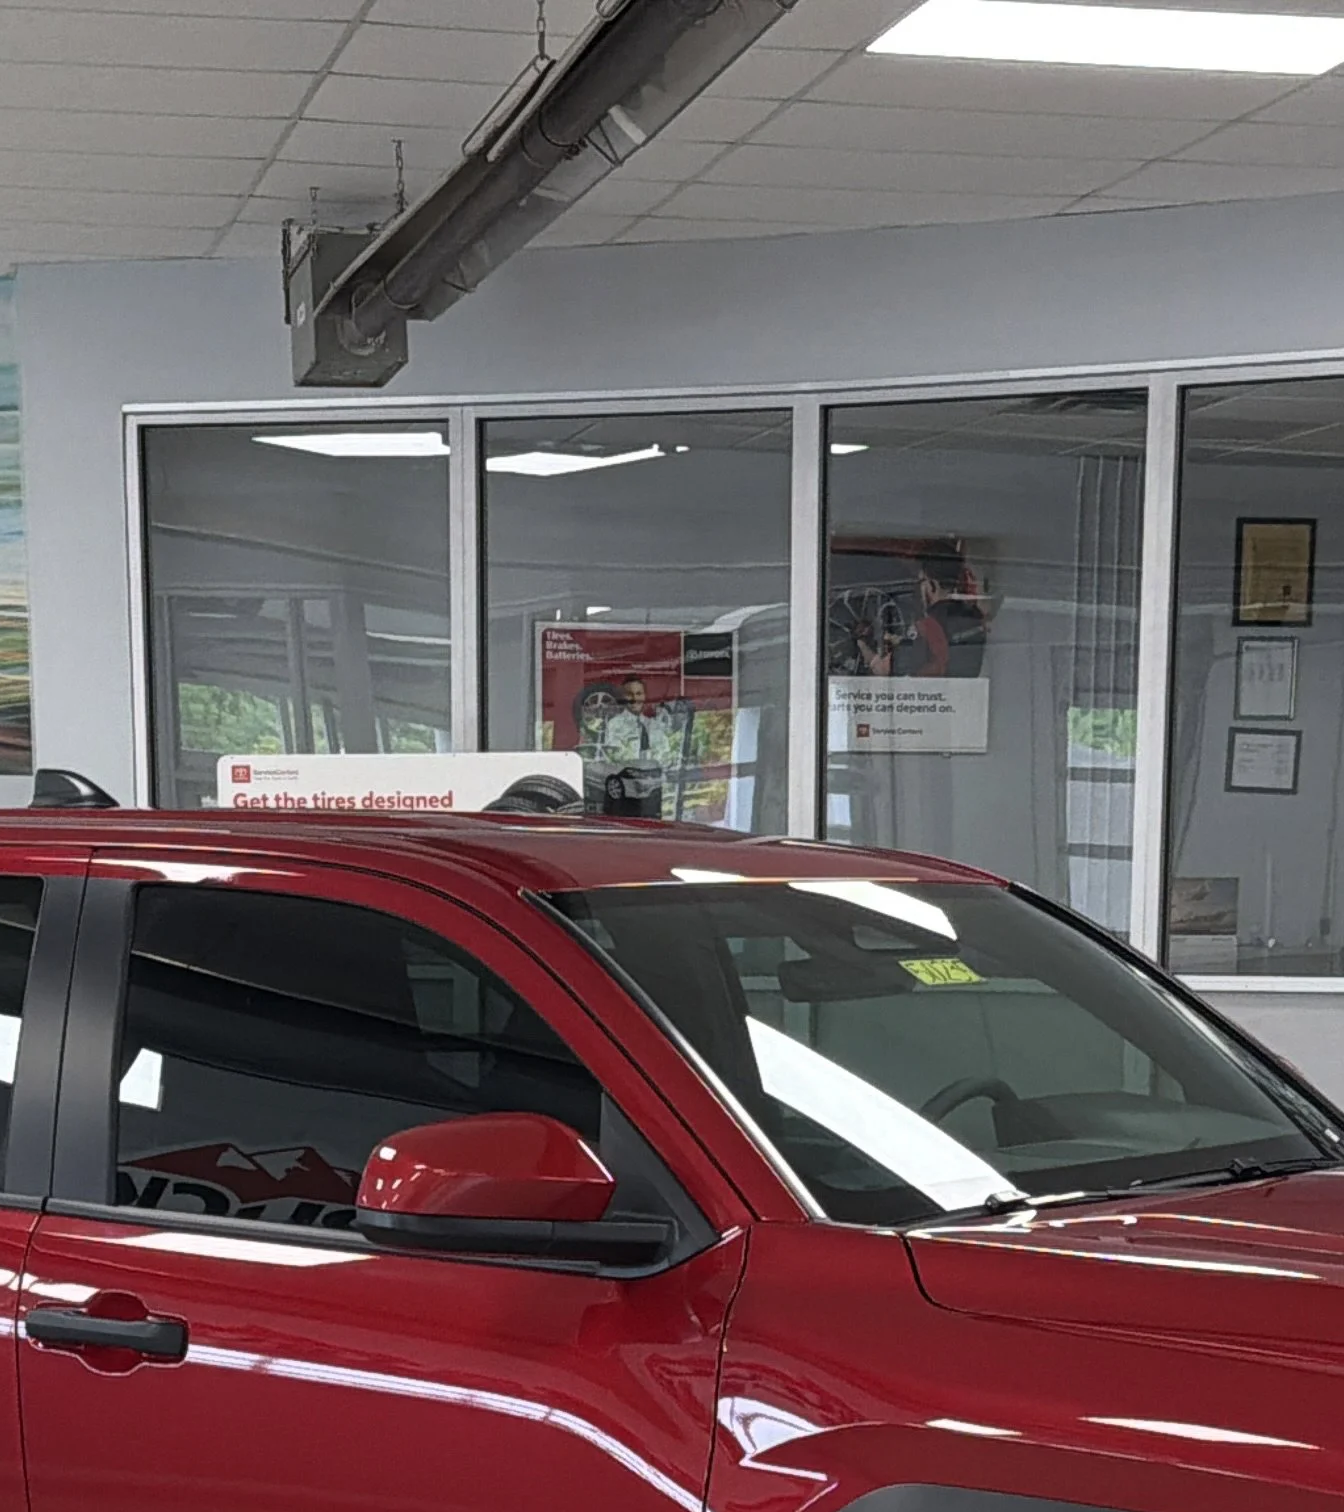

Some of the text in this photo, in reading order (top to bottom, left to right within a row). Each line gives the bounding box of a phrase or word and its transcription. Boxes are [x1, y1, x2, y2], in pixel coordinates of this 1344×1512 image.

[835, 690, 872, 701] Service
[875, 693, 894, 702] you
[897, 693, 916, 701] can
[853, 705, 873, 714] you
[875, 704, 894, 712] can
[896, 703, 937, 714] depend
[233, 790, 454, 811] Get the tires designed
